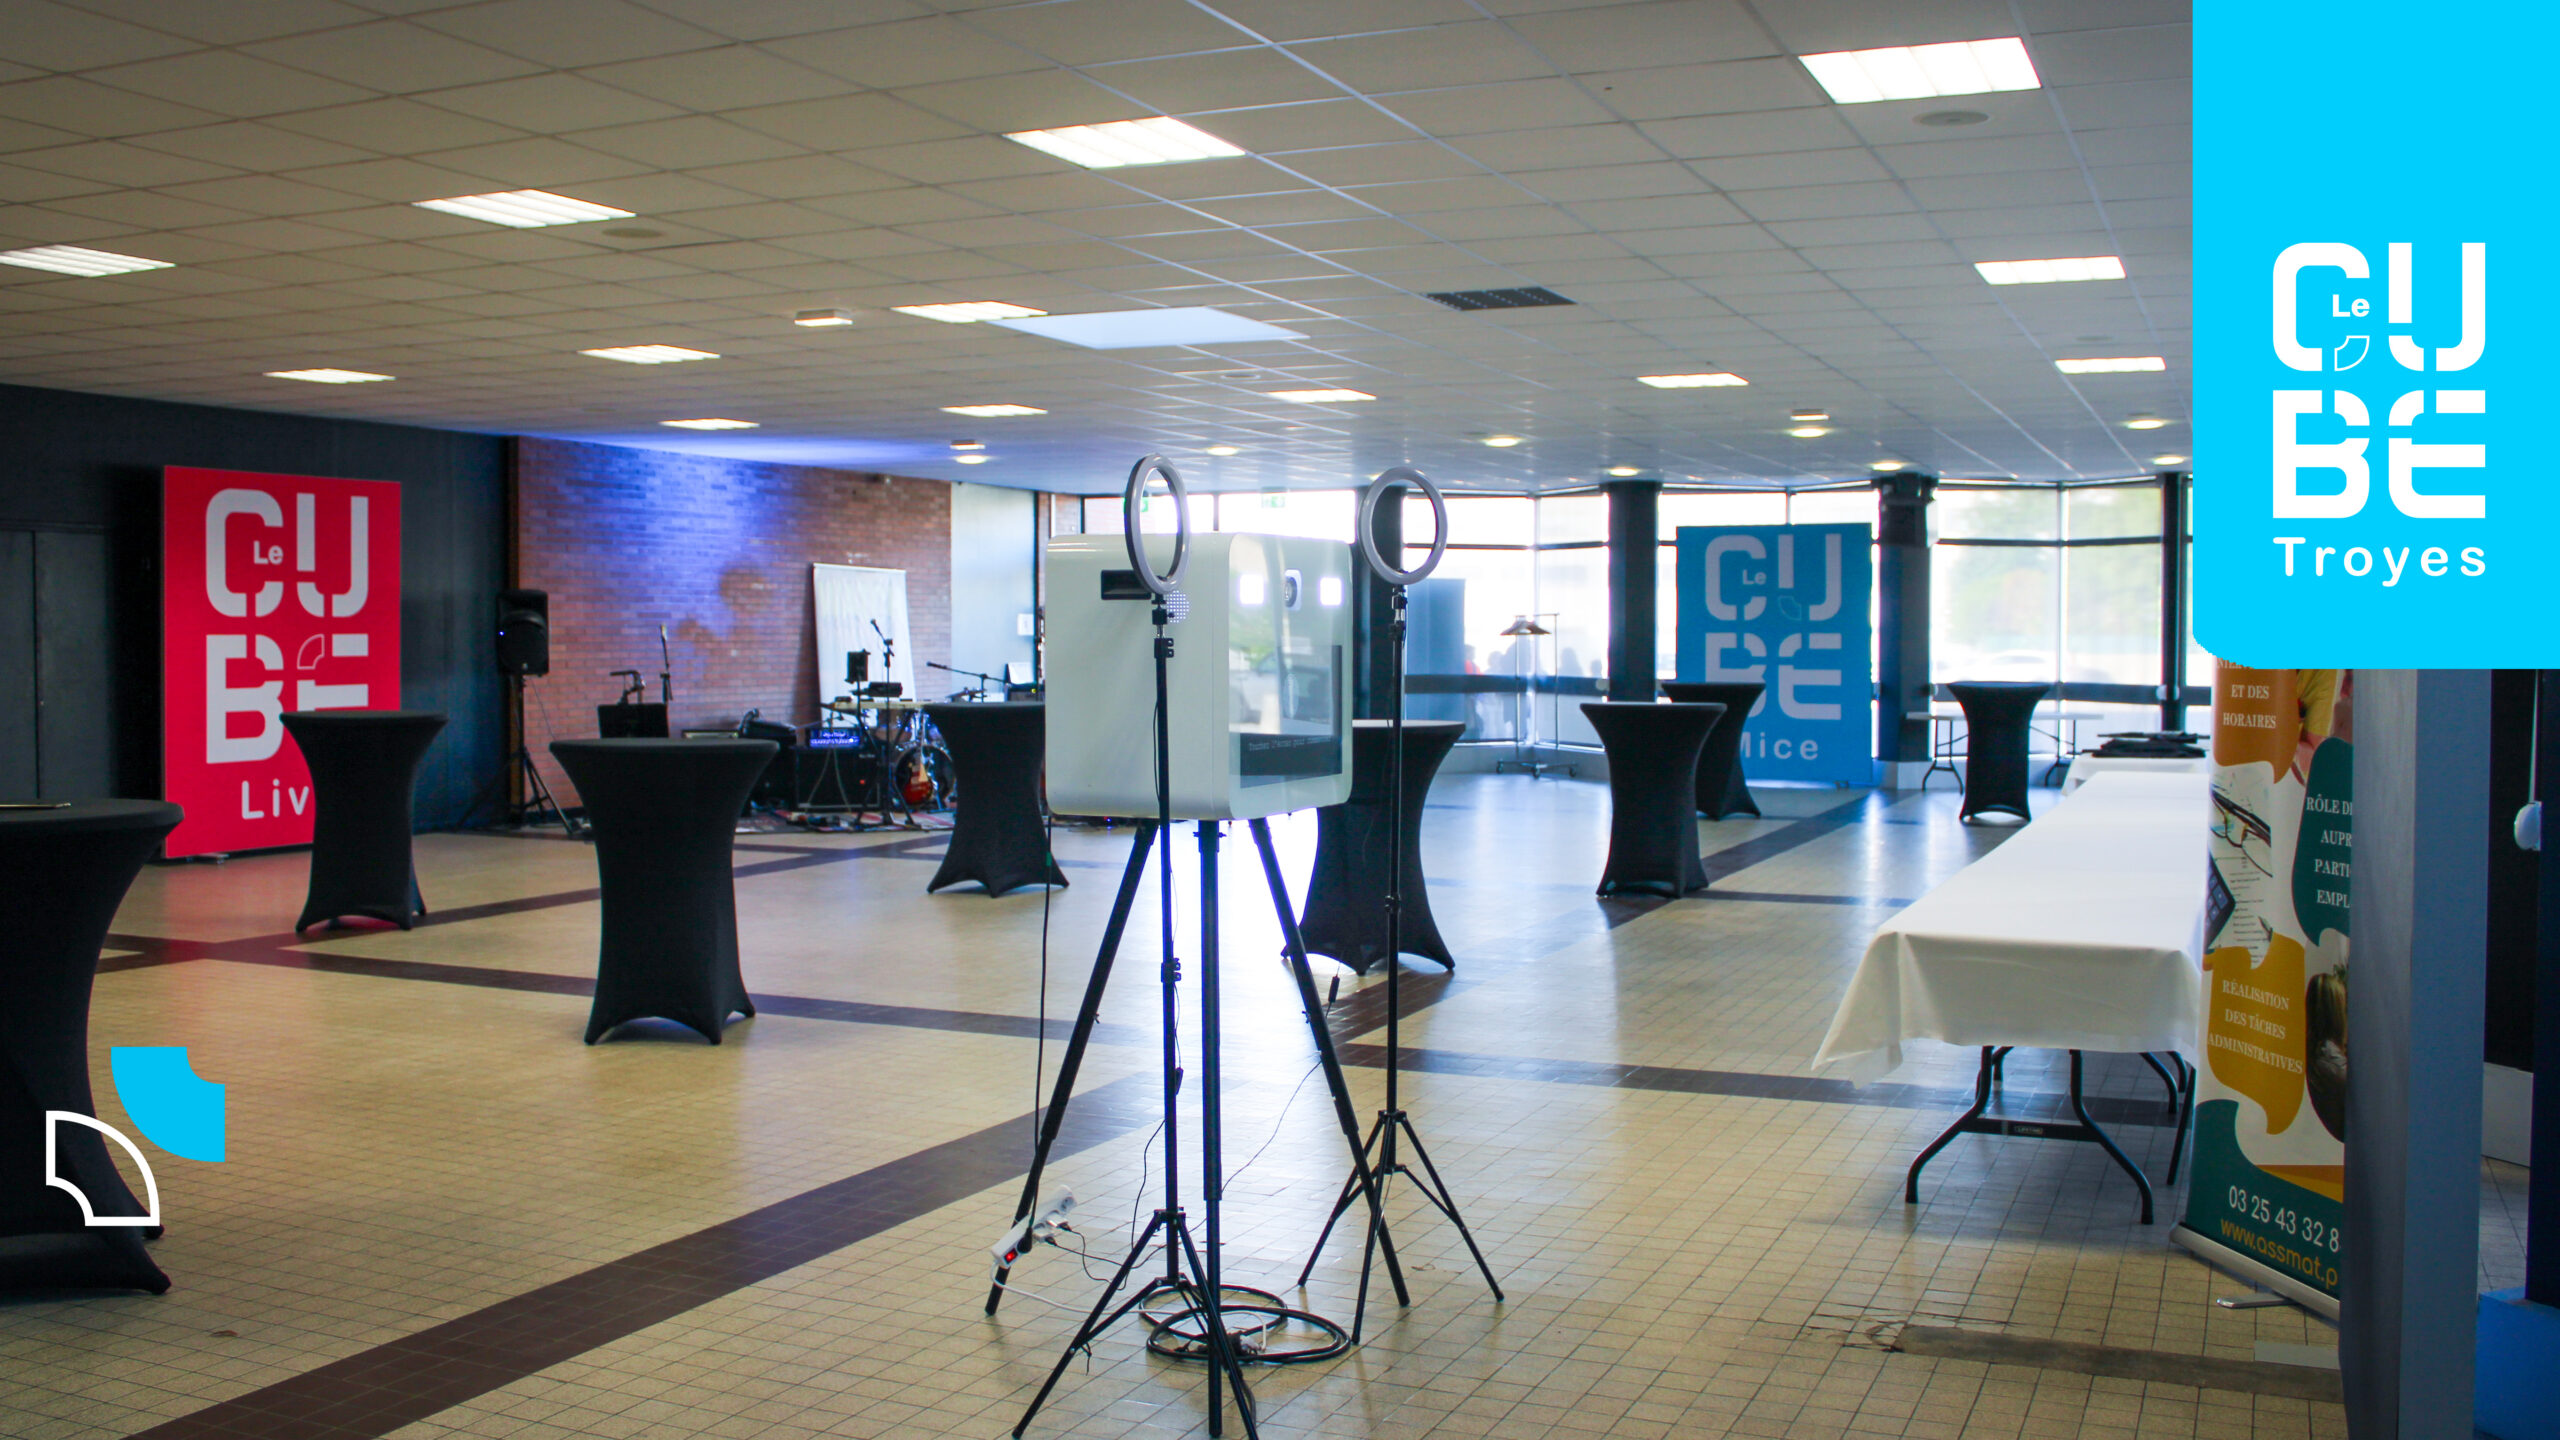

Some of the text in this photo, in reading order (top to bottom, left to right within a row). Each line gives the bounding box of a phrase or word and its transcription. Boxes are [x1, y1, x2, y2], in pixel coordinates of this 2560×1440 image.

[253, 540, 283, 565] Le
[1742, 569, 1767, 585] Le
[2231, 684, 2270, 699] ET DES
[2223, 712, 2277, 729] HORAIRES
[2306, 793, 2339, 814] RÔLE
[2314, 859, 2351, 878] PARTI
[2222, 978, 2290, 1011] RÉALISATION
[2225, 1008, 2247, 1027] DES
[2208, 1032, 2304, 1075] ADMINISTRATIVES
[2228, 1184, 2341, 1253] 03 25 43 32 8
